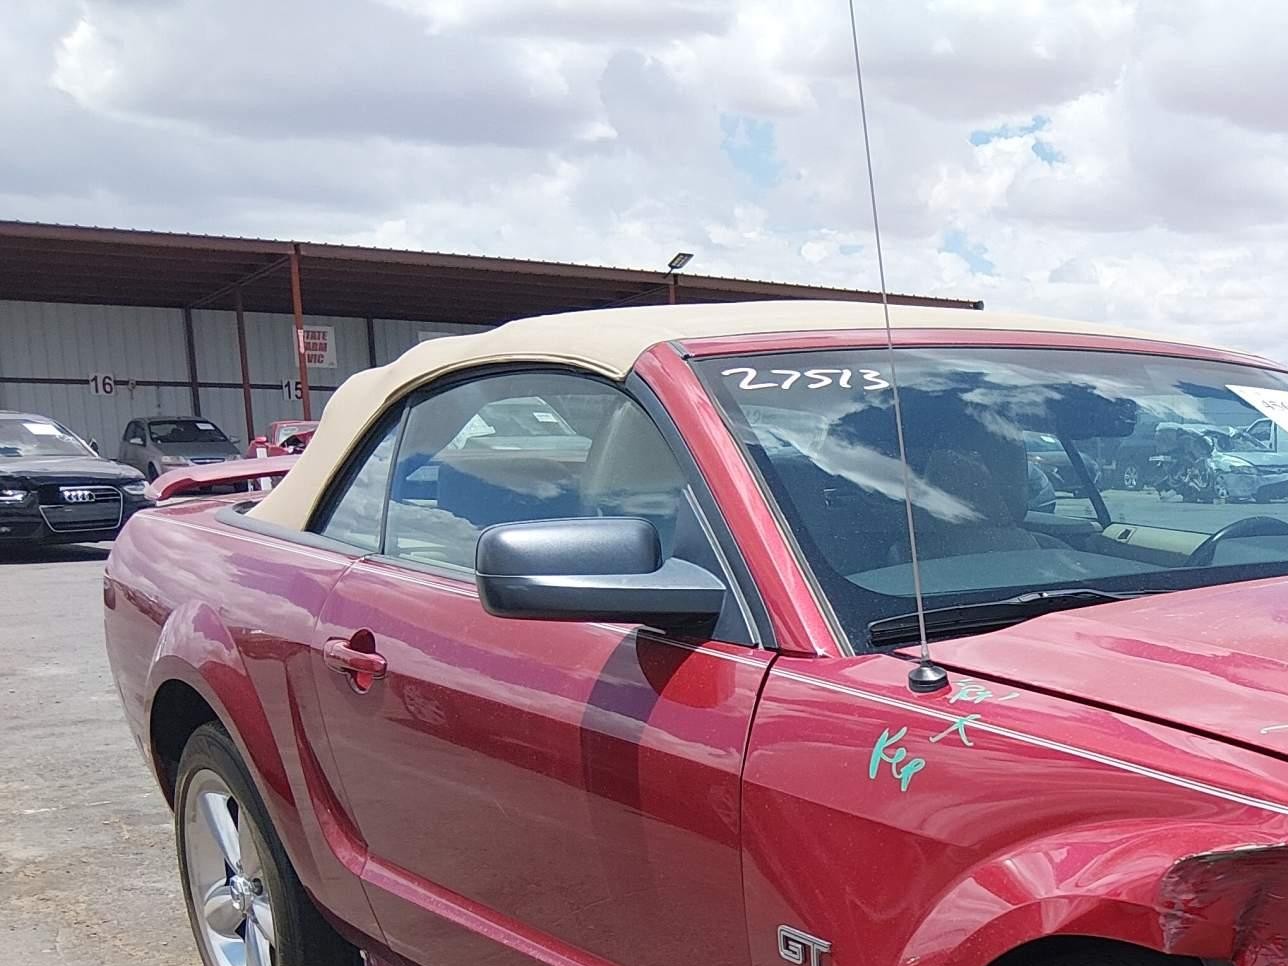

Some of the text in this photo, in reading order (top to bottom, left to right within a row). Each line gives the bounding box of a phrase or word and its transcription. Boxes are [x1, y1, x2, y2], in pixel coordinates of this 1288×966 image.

[303, 330, 328, 341] TATE
[304, 341, 328, 353] ARM
[90, 375, 114, 394] 16
[721, 367, 890, 390] 27513
[284, 380, 304, 400] 15
